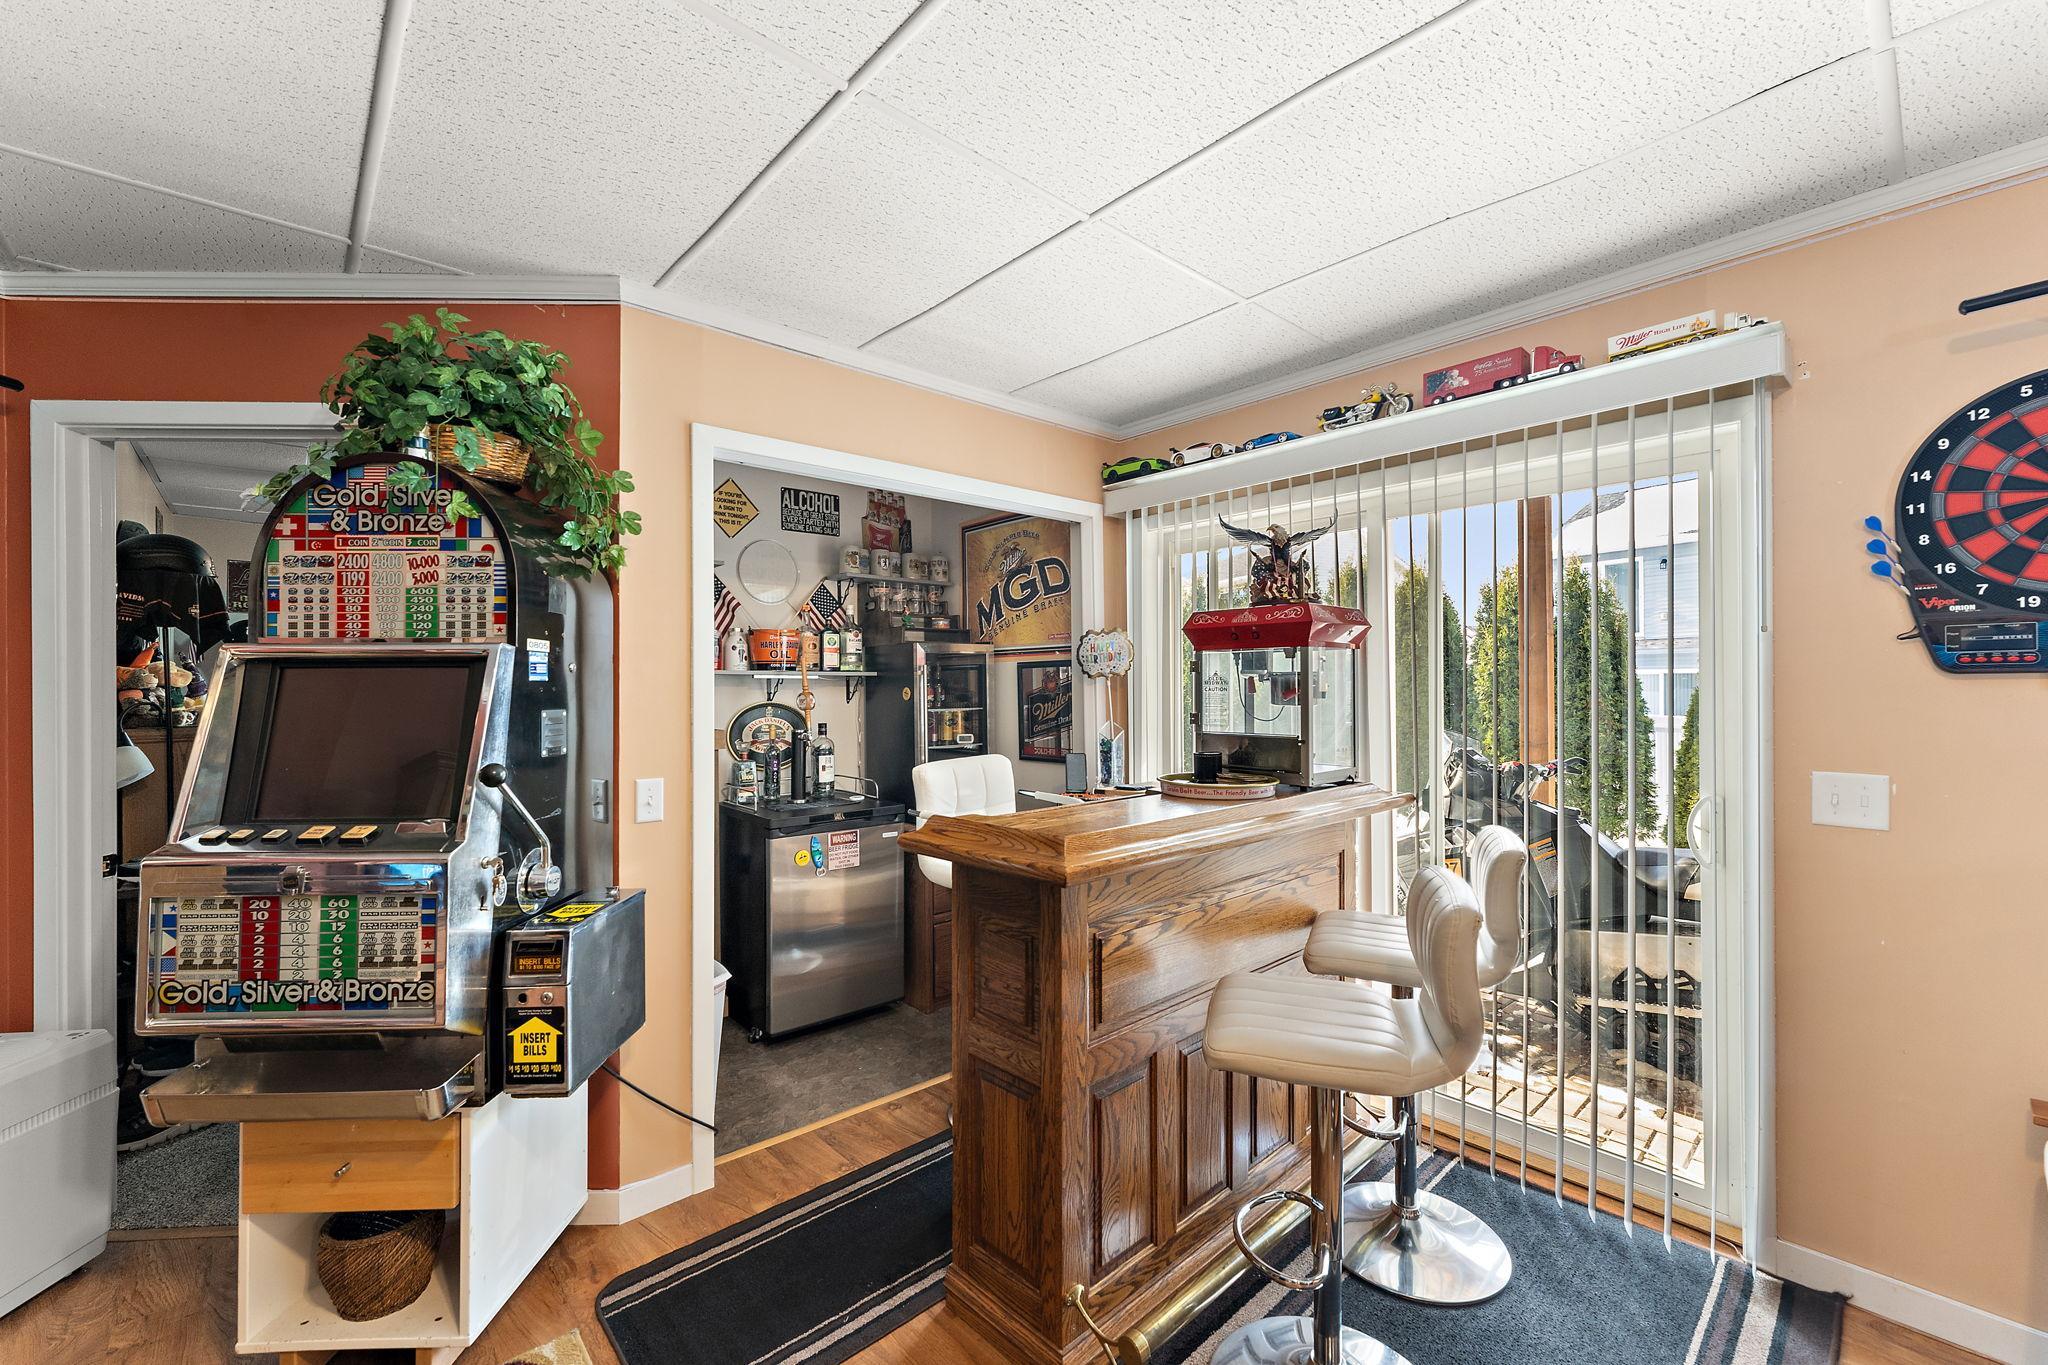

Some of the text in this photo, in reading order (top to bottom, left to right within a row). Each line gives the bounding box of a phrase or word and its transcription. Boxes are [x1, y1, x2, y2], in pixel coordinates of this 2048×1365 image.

[1616, 330, 1653, 349] Miller
[2020, 385, 2033, 397] 5
[1967, 407, 1990, 421] 12
[1938, 438, 1950, 450] 9
[1910, 470, 1932, 482] 14
[313, 484, 455, 508] Gold, Silve
[714, 497, 737, 505] LOOKING
[782, 490, 839, 515] ALCOHOL
[782, 508, 802, 517] BECAUSE
[1906, 503, 1926, 515] 11
[329, 508, 447, 533] & Bronze
[783, 515, 798, 523] EVER
[799, 517, 825, 526] STARTED
[783, 522, 839, 535] SOMEONE EATING SALAD
[348, 538, 369, 546] COIN
[384, 538, 403, 546] COIN
[417, 538, 438, 546] COIN
[1919, 534, 1930, 547] 8
[338, 554, 369, 569] 2400
[407, 554, 440, 571] 10,000
[999, 546, 1027, 574] Miller
[1934, 563, 1957, 575] 16
[341, 571, 366, 586] 1199
[412, 570, 439, 586] 5,000
[1976, 583, 1989, 595] 7
[410, 596, 434, 604] 450
[976, 556, 1071, 640] MGD
[1918, 597, 1960, 609] Viper
[2017, 596, 2042, 608] 19
[345, 605, 361, 613] 80
[410, 605, 434, 613] 240
[1949, 604, 1977, 612] ORION
[345, 613, 361, 621] 50
[413, 613, 432, 621] 150
[988, 596, 1065, 639] GENUINE DRAFT
[345, 622, 362, 630] 40
[413, 622, 432, 630] 120
[769, 650, 792, 659] OIL
[1032, 692, 1072, 720] Miller
[1180, 786, 1192, 794] Belt
[831, 833, 857, 844] WARNING
[842, 843, 859, 851] FRIDGE
[249, 898, 350, 909] 20 40 60
[250, 910, 350, 920] 10 20 30
[255, 921, 346, 932] 5 10 15
[254, 934, 343, 945] 2 4 6
[253, 946, 343, 957] 2 4 6
[253, 958, 343, 969] 2 4 6
[519, 957, 561, 965] INSERT BILLS
[158, 978, 435, 1006] Gold, Silver & Bronze
[520, 1032, 551, 1044] INSERT
[523, 1044, 547, 1056] BILLS
[521, 1065, 530, 1073] $10
[531, 1064, 540, 1073] $20
[551, 1064, 561, 1073] $100
